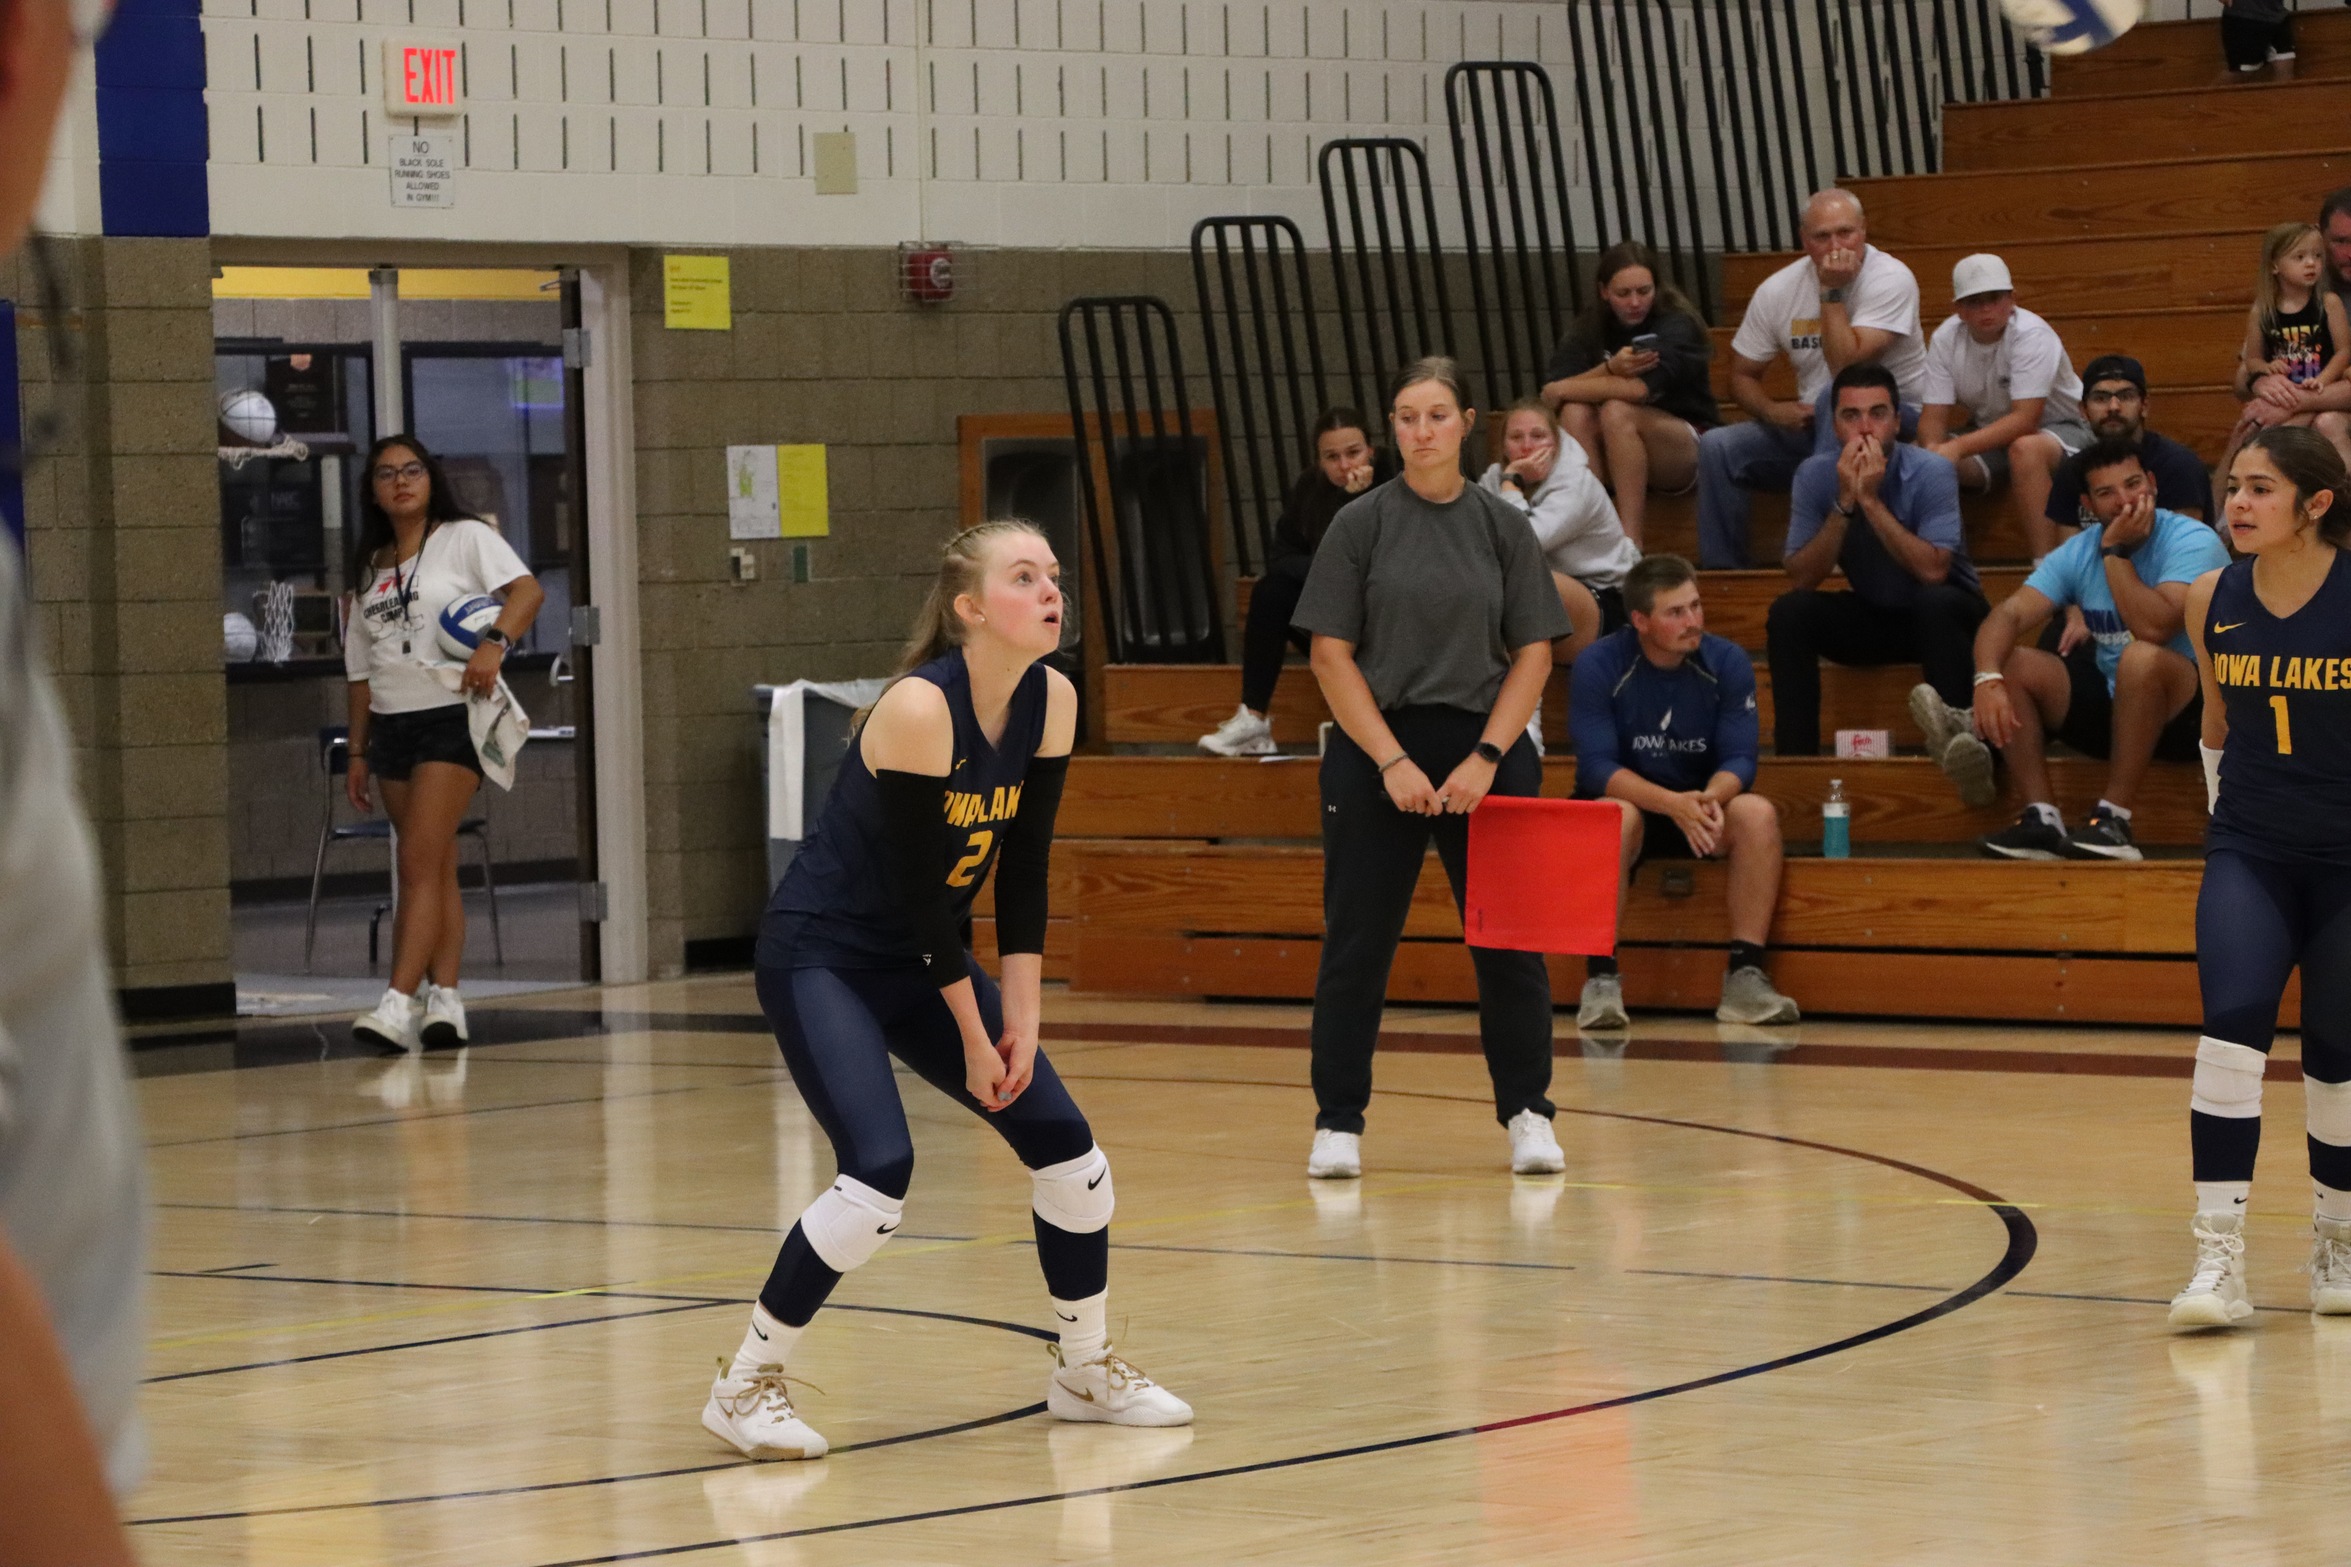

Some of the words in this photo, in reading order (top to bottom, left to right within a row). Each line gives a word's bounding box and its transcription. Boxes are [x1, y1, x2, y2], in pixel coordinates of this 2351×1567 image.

[404, 48, 456, 104] EXIT
[413, 141, 429, 154] NO
[399, 158, 422, 167] BLACK
[426, 159, 444, 168] SOLE
[395, 170, 423, 178] RUNNING
[427, 170, 450, 179] SHOES
[406, 182, 440, 190] ALLOWED
[1791, 337, 1822, 349] BAS
[2214, 653, 2260, 687] IOWA
[2269, 656, 2351, 691] LAKES
[2269, 695, 2292, 755] 1
[946, 830, 993, 887] 2
